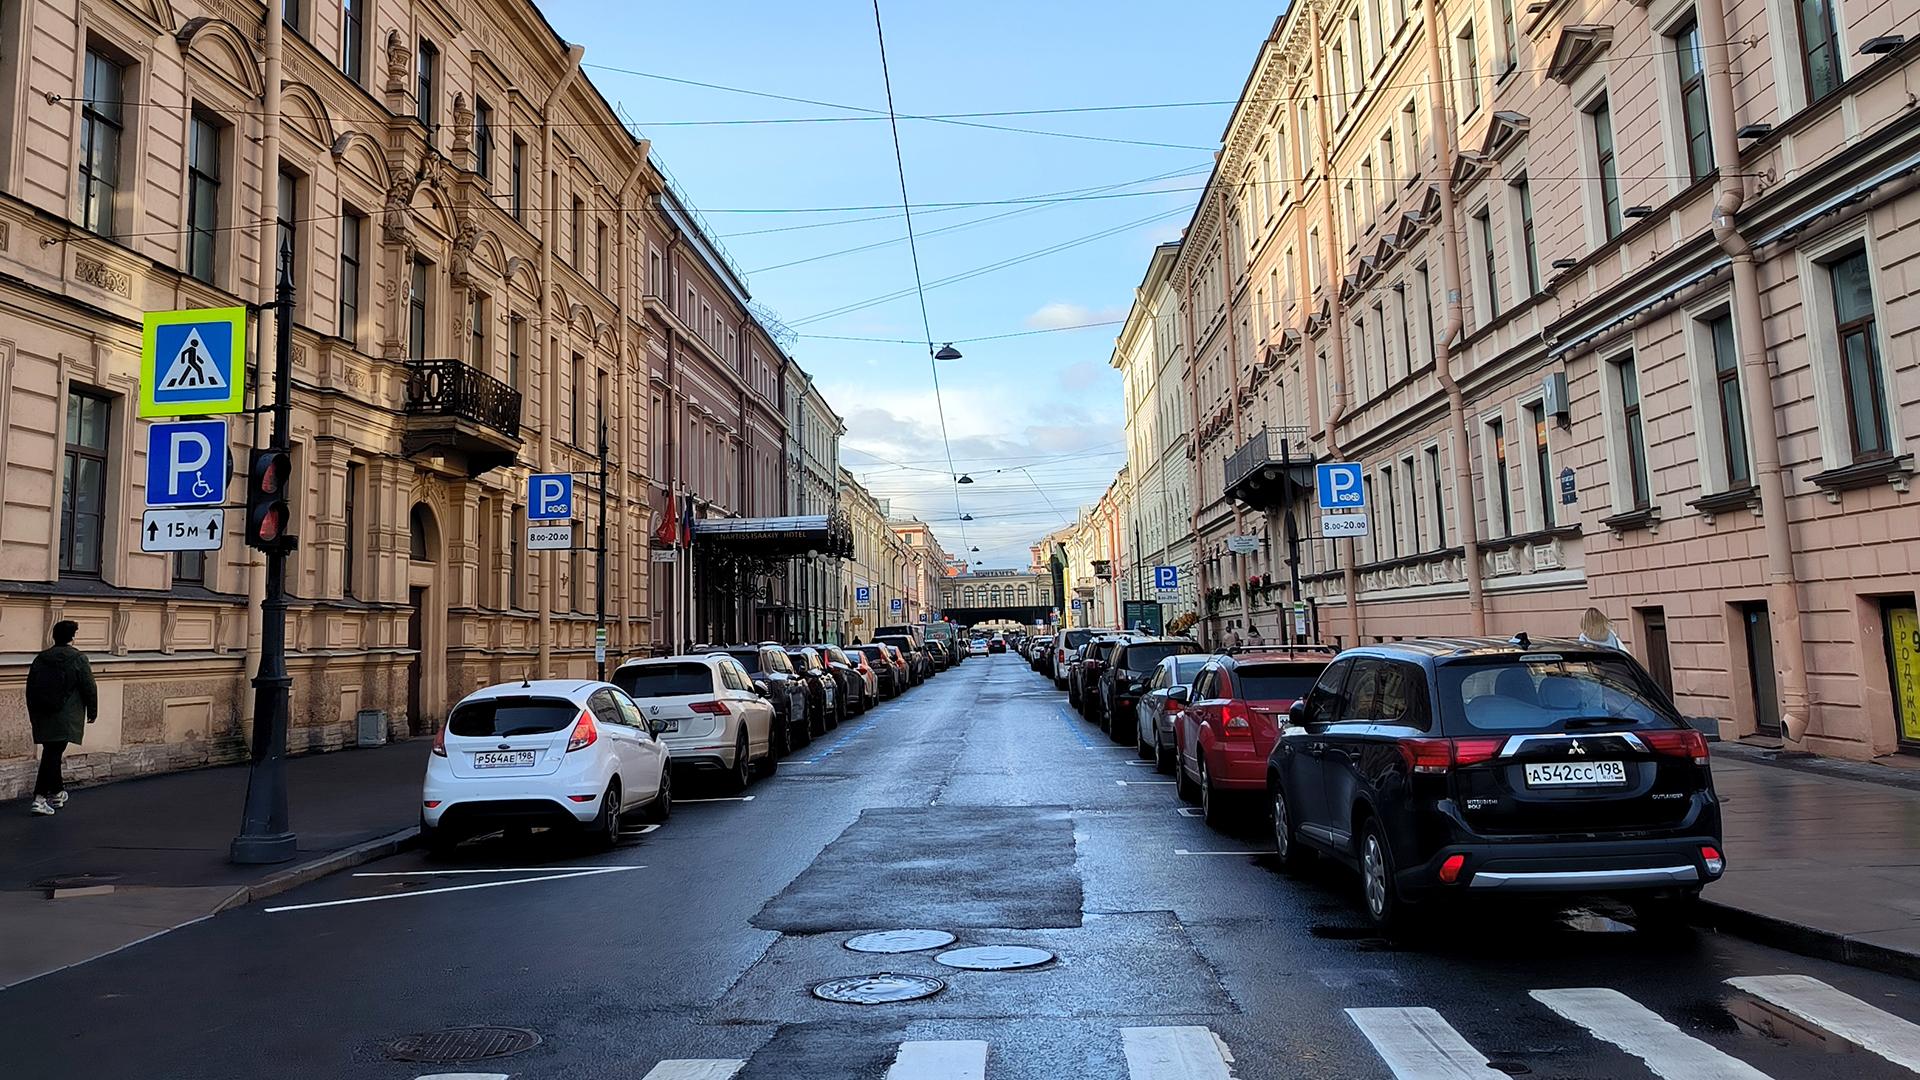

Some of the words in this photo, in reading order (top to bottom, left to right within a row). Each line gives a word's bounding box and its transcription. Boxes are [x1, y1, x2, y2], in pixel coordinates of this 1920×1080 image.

[168, 431, 212, 496] P
[1329, 468, 1355, 503] P
[540, 479, 564, 514] P
[1324, 521, 1366, 530] 8.00-20.00
[530, 533, 569, 541] 8.00-20.00
[1161, 568, 1173, 586] P
[859, 588, 868, 600] P
[1897, 615, 1917, 725] ПРОДАЖА
[518, 752, 532, 760] 198
[1532, 765, 1593, 781] А542СС
[1596, 763, 1620, 775] 198
